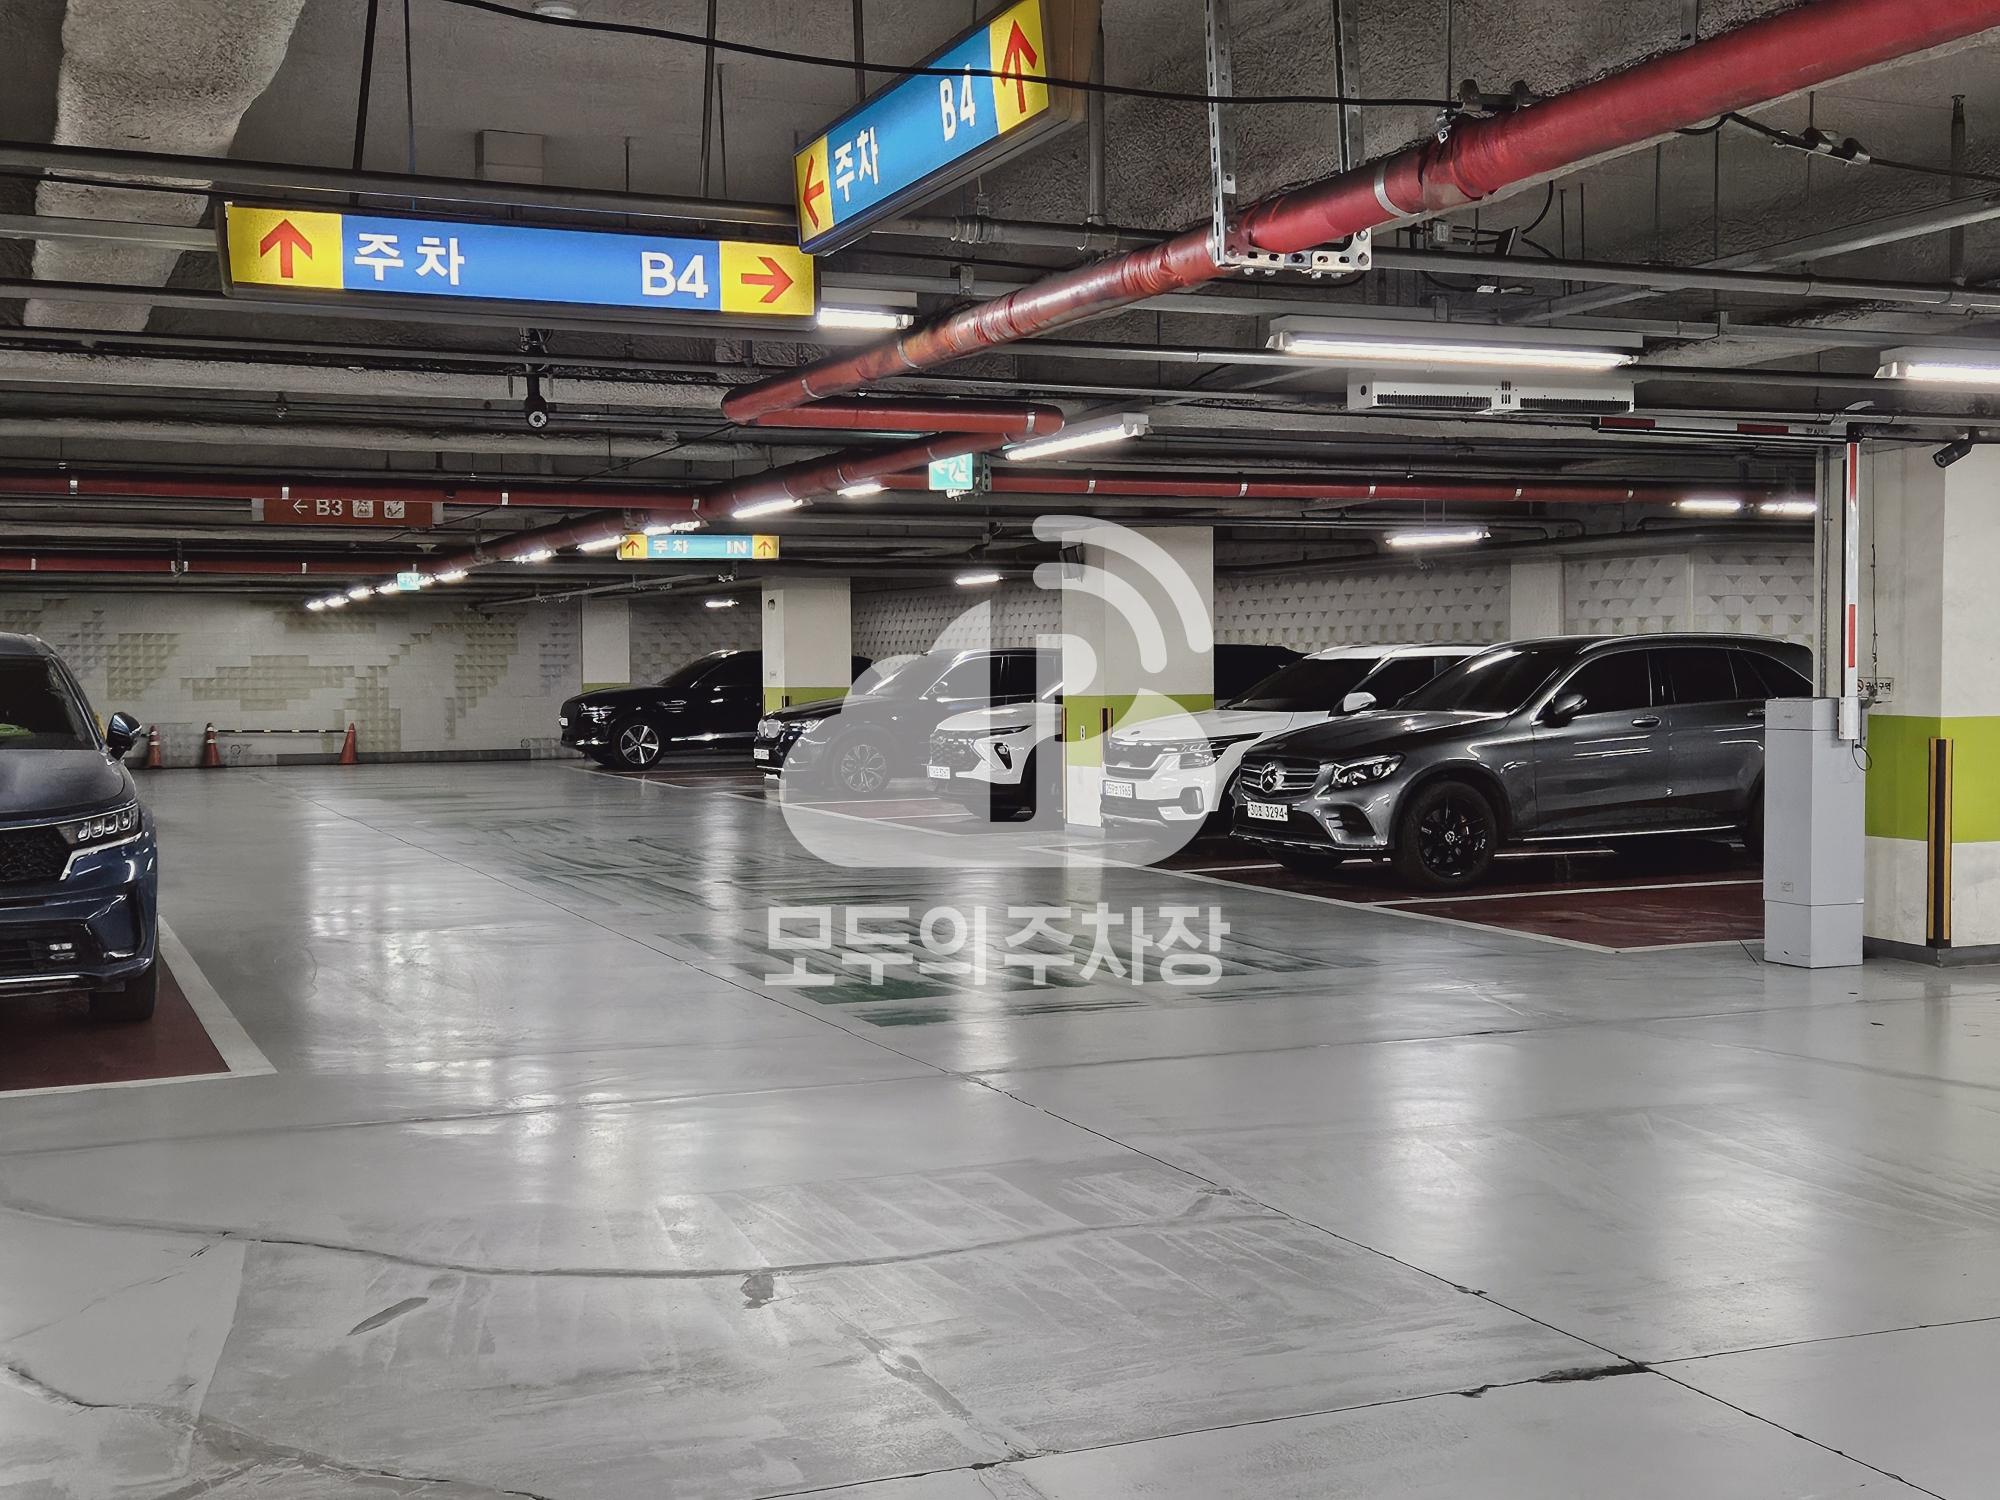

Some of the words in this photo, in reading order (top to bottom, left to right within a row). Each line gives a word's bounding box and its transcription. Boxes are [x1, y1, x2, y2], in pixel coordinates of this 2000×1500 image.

[834, 126, 879, 202] 주차
[938, 63, 976, 142] B4
[354, 233, 465, 286] 주차
[641, 250, 709, 299] B4
[316, 499, 343, 516] B3
[653, 540, 689, 554] 주차
[726, 540, 747, 554] IN
